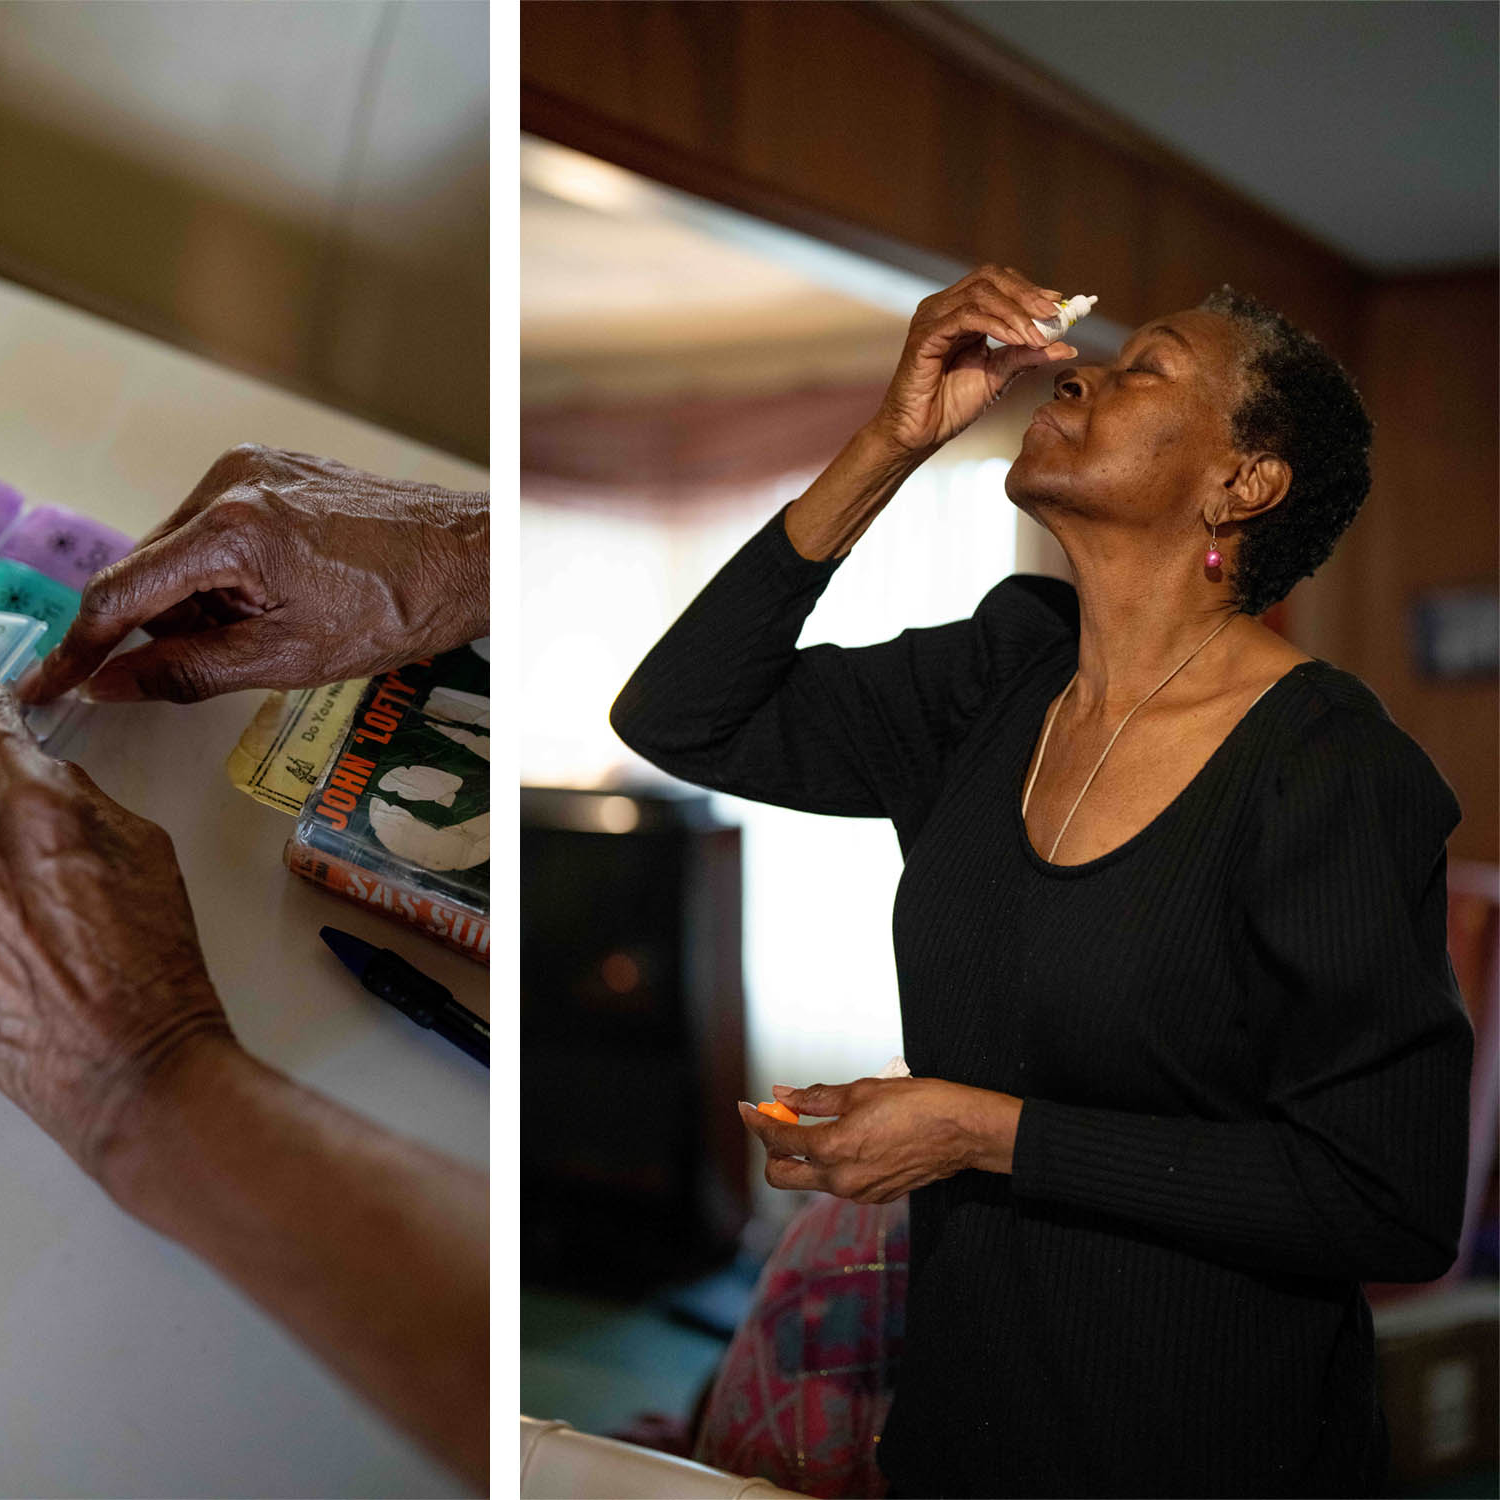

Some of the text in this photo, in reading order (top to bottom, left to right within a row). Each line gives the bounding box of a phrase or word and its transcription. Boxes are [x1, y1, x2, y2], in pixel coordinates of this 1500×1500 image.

[301, 699, 335, 742] Do You
[316, 752, 377, 831] JOHN
[346, 873, 421, 923] SAS
